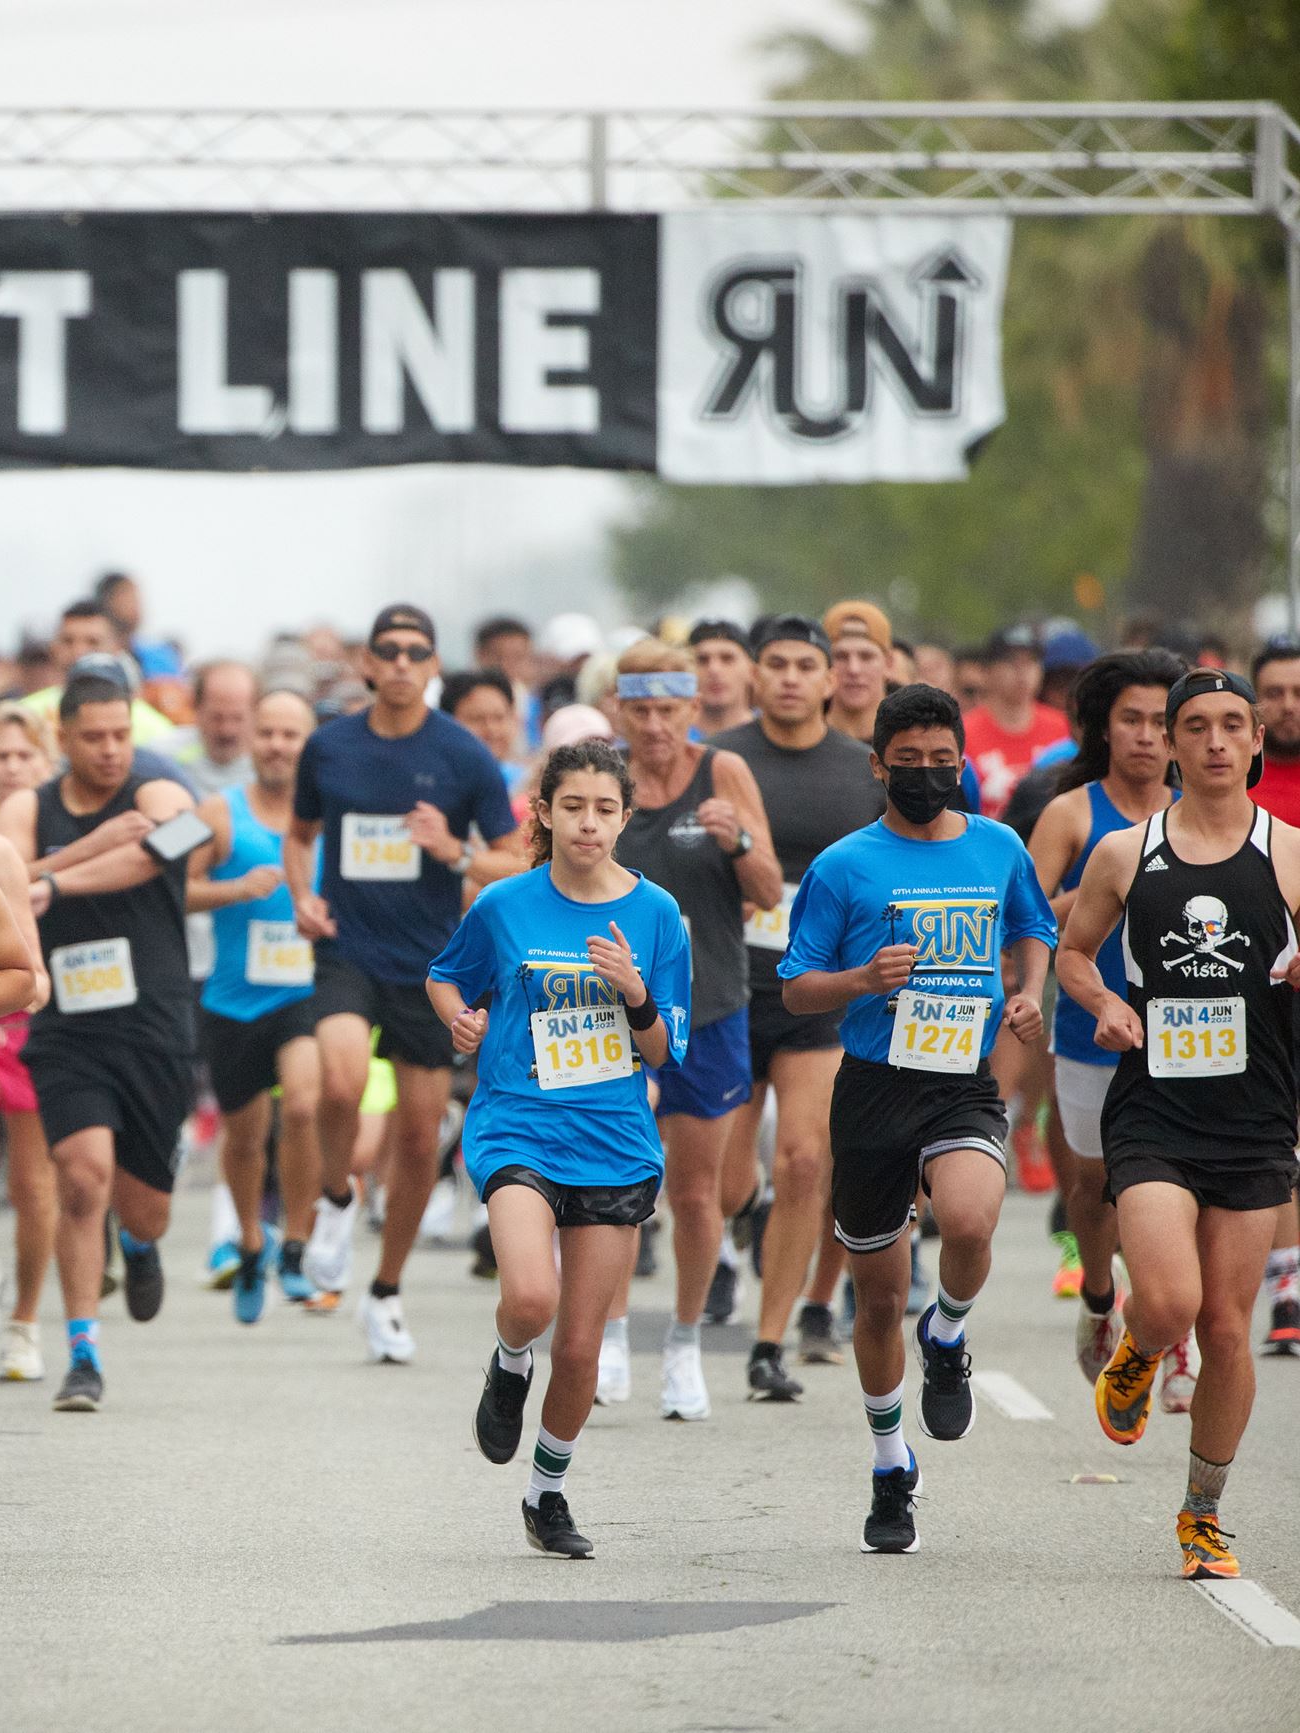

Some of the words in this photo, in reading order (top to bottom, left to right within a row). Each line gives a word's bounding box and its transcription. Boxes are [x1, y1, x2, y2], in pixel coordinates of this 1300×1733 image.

[176, 267, 601, 437] LINE
[912, 887, 942, 895] ANNUAL
[943, 886, 978, 894] FONTANA
[979, 886, 996, 894] DAYS
[528, 948, 546, 956] 67TH
[547, 950, 579, 959] ANNUAL
[1180, 960, 1229, 978] vista
[912, 976, 967, 987] FONTANA,
[968, 977, 983, 988] CA
[582, 1013, 594, 1031] 4
[594, 1011, 615, 1023] JUN
[946, 1004, 957, 1021] 4
[957, 1005, 976, 1015] JUN
[1198, 1007, 1210, 1024] 4
[1211, 1005, 1232, 1017] JUN
[1211, 1016, 1233, 1024] 2022
[595, 1021, 616, 1029] 2022
[903, 1022, 973, 1056] 1274
[1158, 1029, 1237, 1059] 1313
[545, 1033, 623, 1071] 1316
